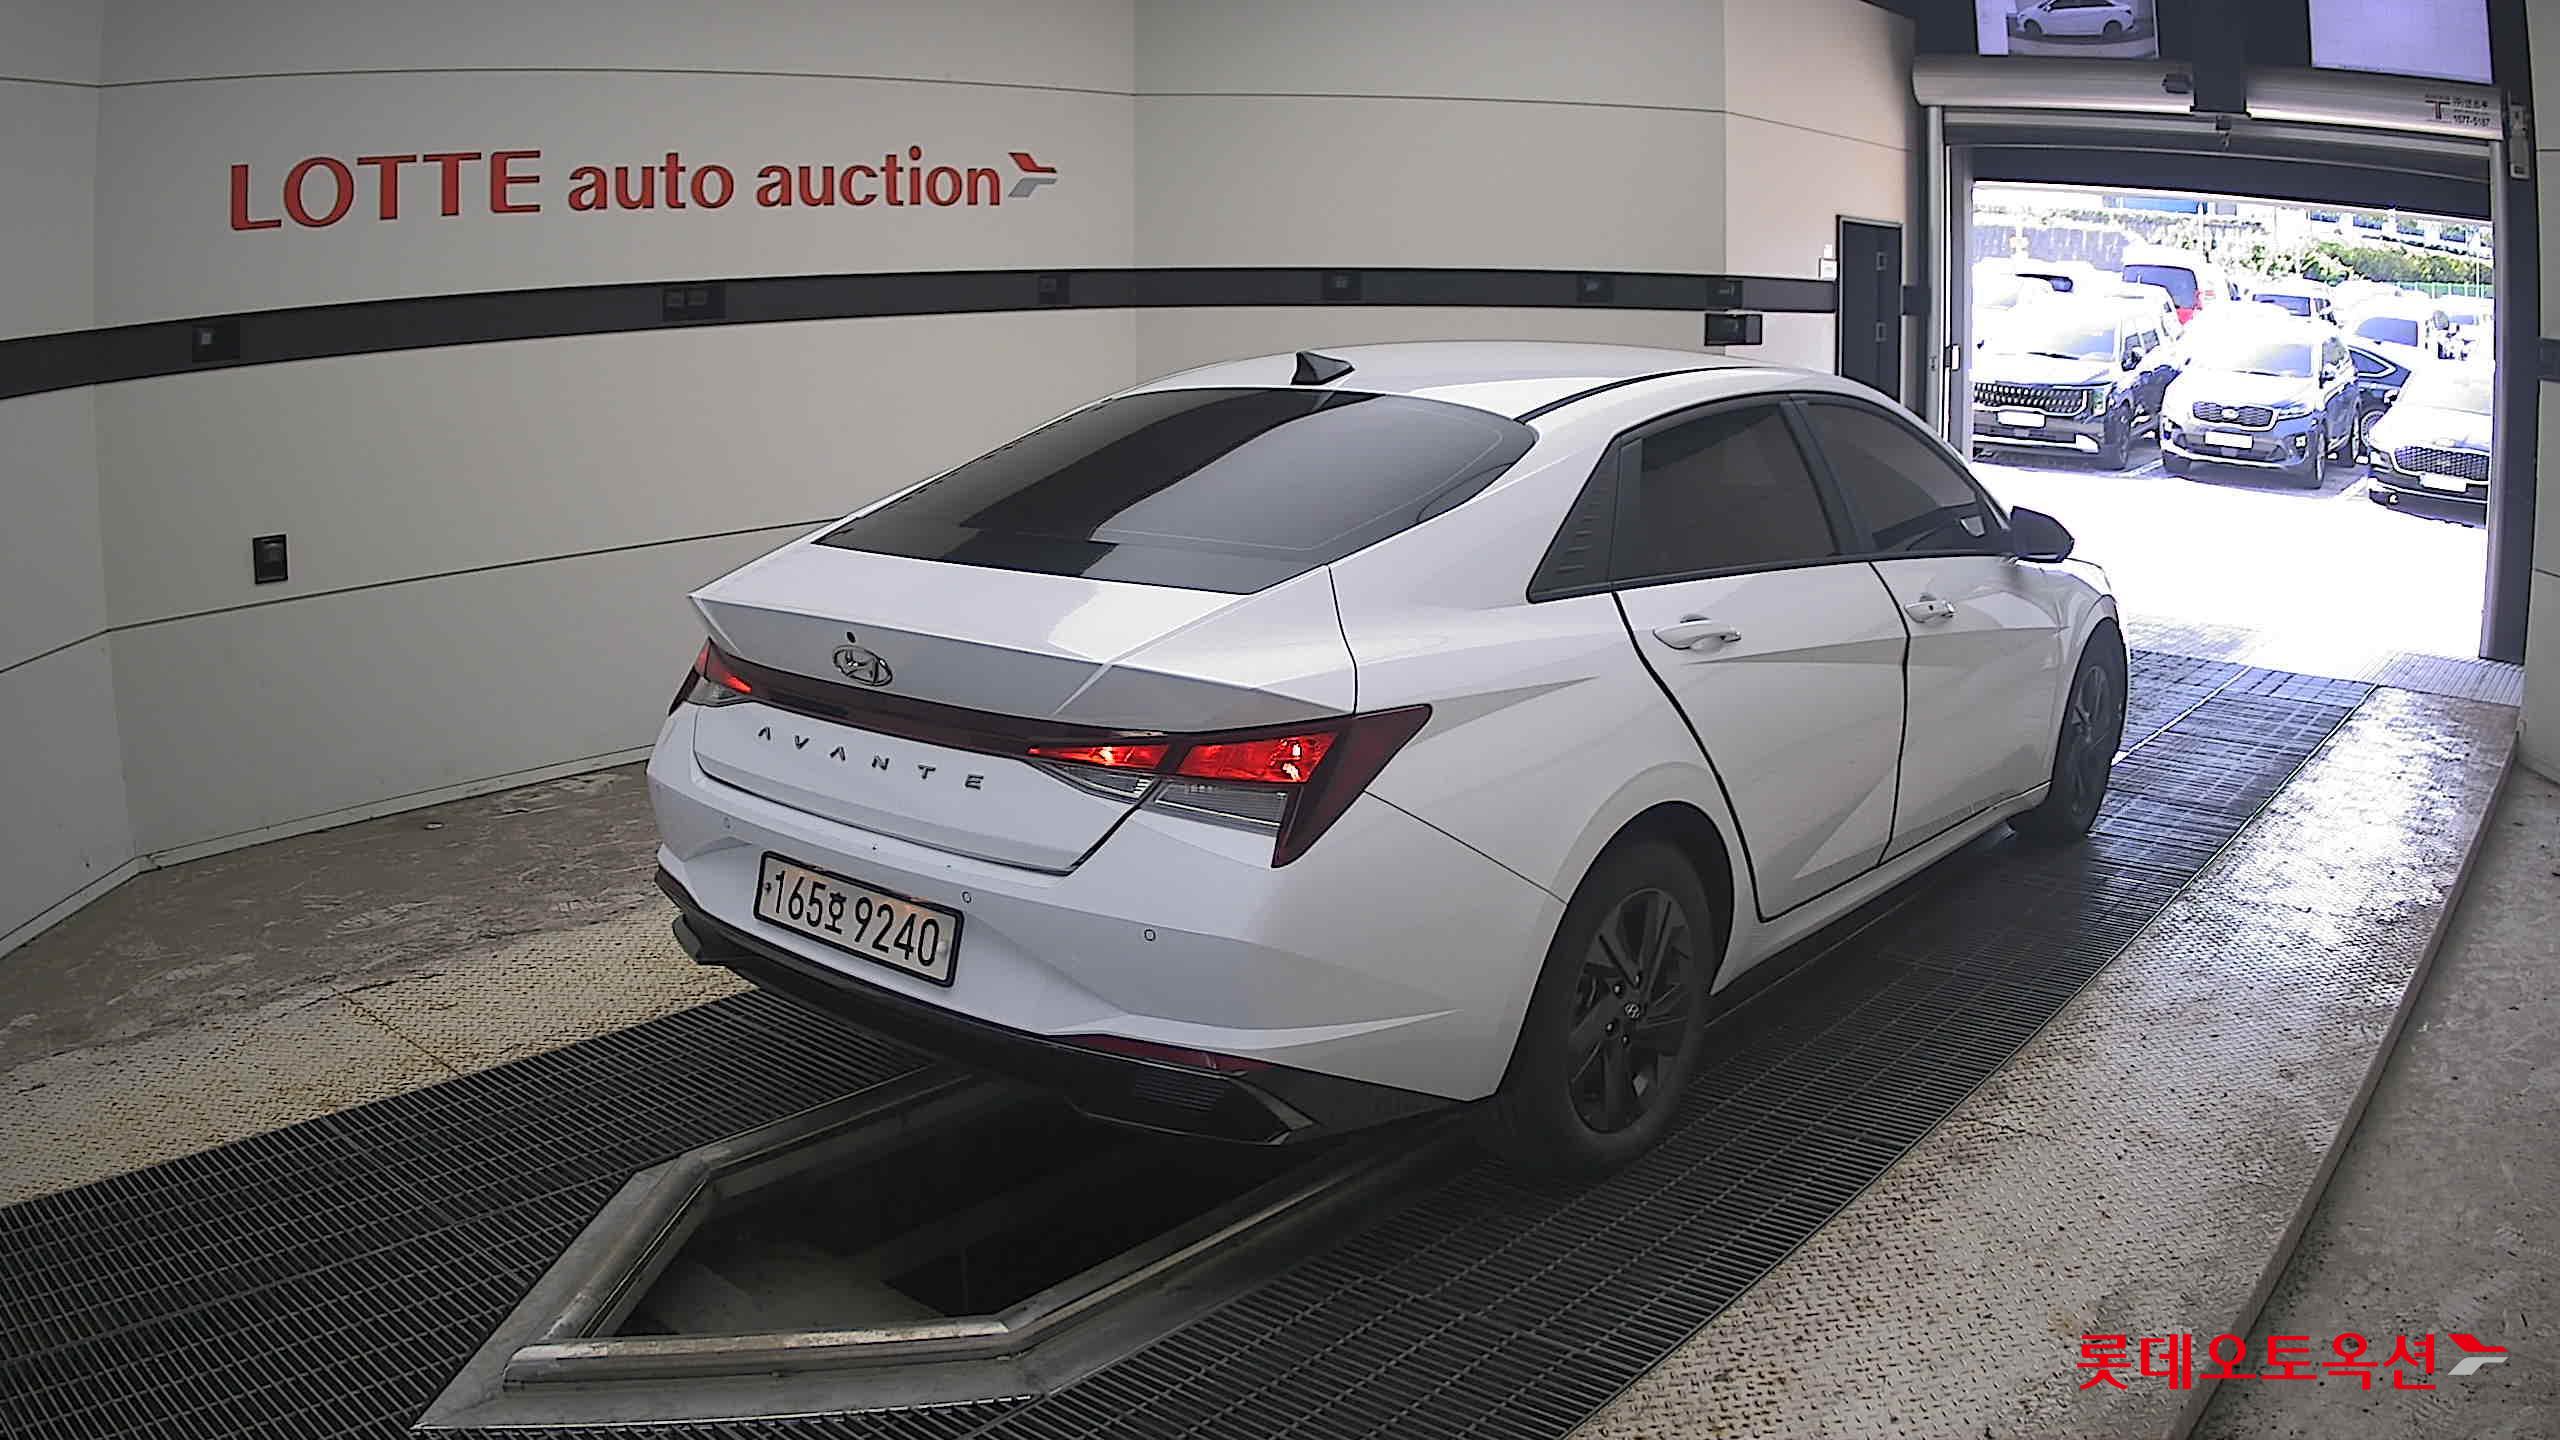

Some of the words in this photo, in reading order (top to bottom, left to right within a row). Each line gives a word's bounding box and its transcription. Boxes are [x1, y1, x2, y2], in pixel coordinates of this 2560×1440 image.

[230, 149, 542, 232] LOTTE
[568, 152, 736, 211] auto
[756, 145, 1001, 207] auction
[758, 726, 985, 790] AVANTE
